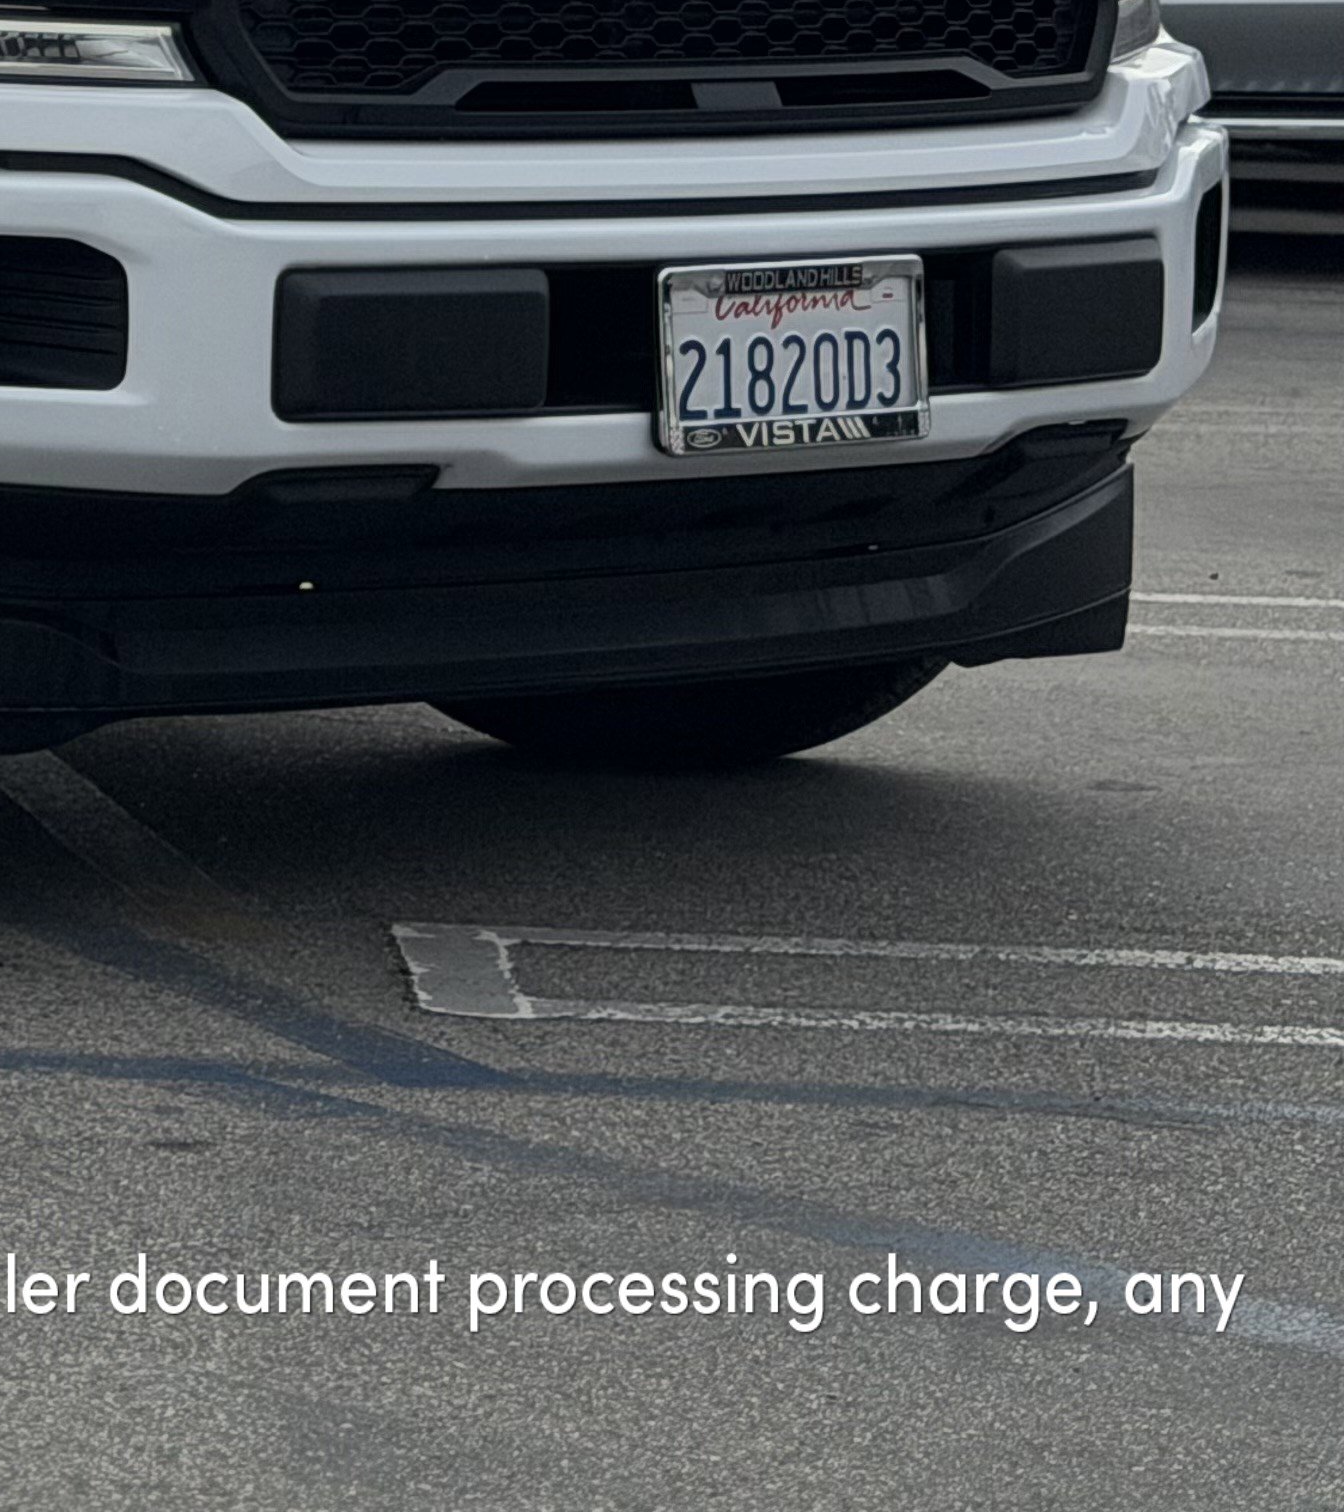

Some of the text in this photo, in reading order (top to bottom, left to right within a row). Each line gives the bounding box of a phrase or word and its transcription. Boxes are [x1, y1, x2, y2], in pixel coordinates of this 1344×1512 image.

[714, 288, 872, 330] California
[678, 327, 902, 421] 21820D3
[735, 417, 842, 447] VISTA
